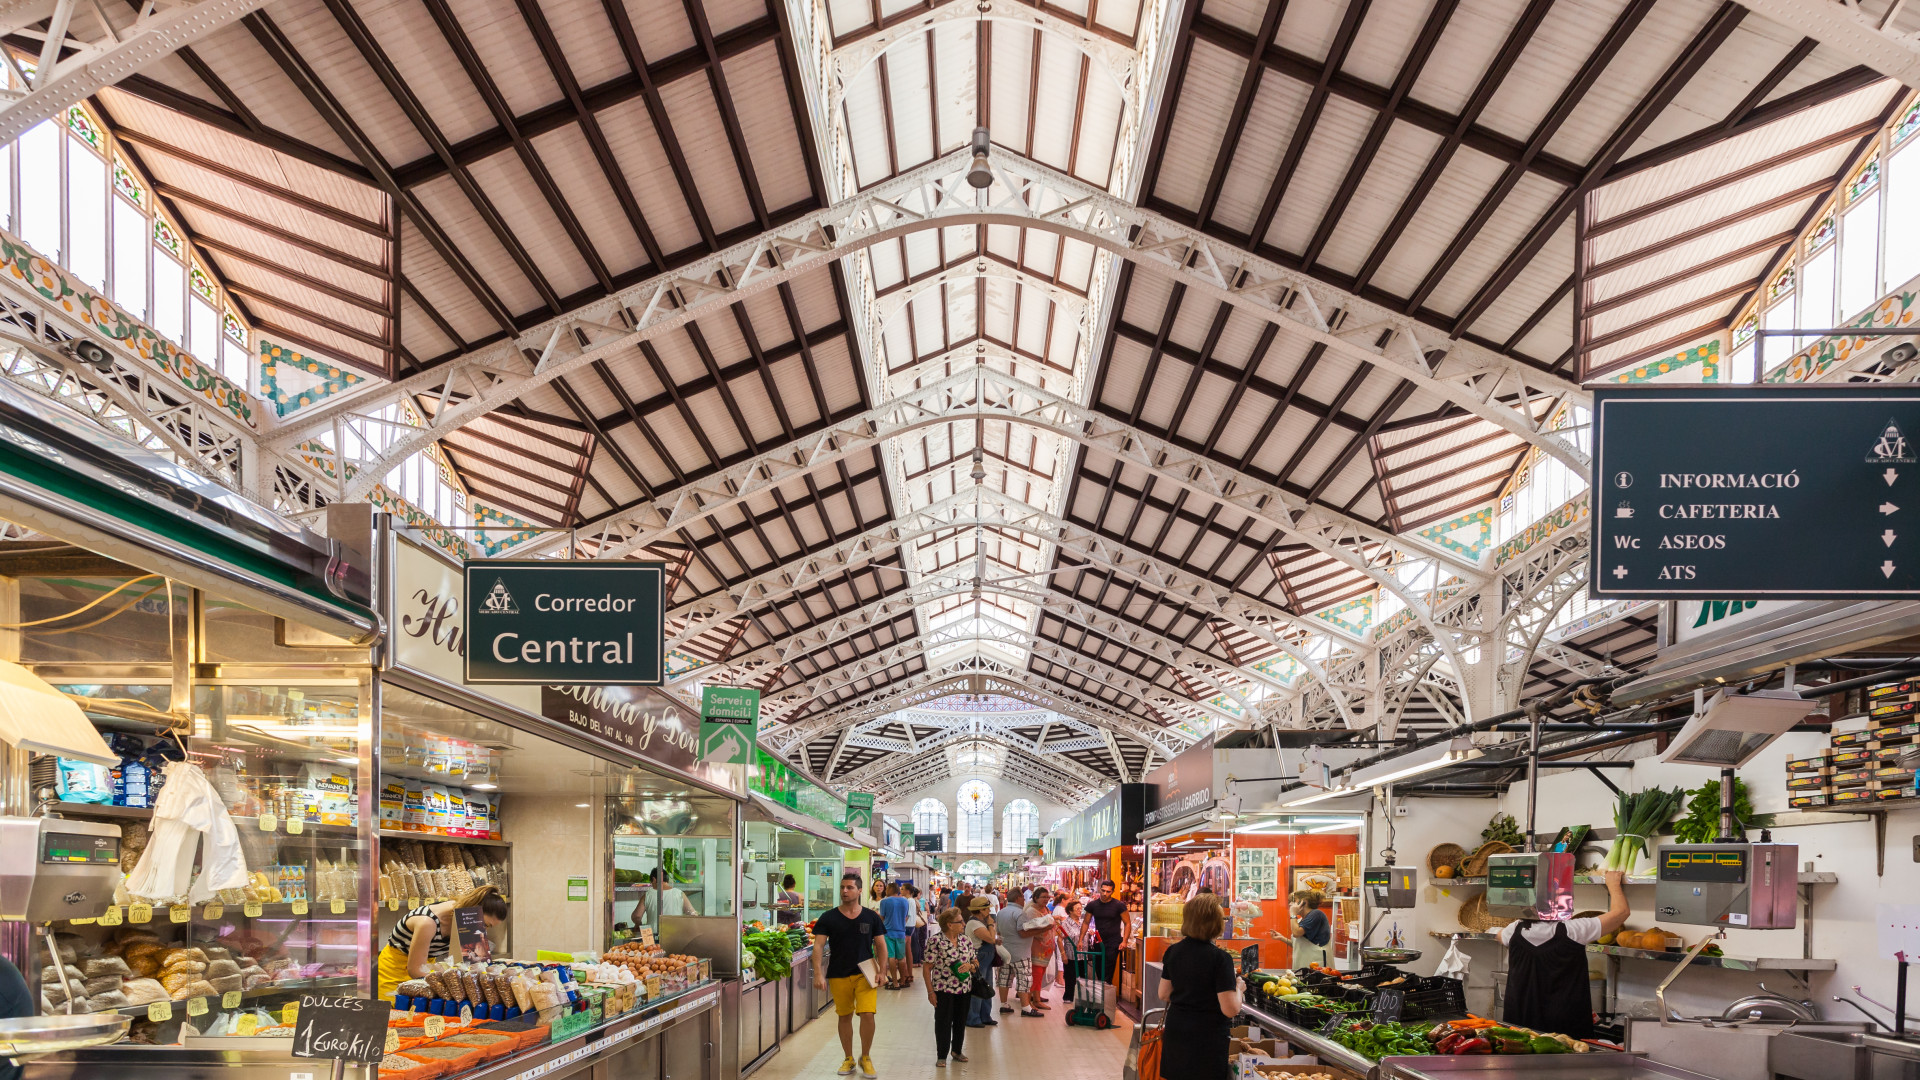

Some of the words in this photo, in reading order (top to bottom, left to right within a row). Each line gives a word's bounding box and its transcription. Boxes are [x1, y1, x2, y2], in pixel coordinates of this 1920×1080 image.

[1659, 469, 1800, 489] INFORMACIÓ
[1659, 504, 1781, 519] CAFETERIA
[1658, 534, 1726, 550] ASEOS
[1657, 565, 1697, 580] ATS
[535, 593, 636, 612] Corredor
[492, 632, 633, 664] Central
[549, 685, 640, 726] aura
[710, 693, 743, 705] Servei
[745, 697, 752, 706] a
[569, 709, 588, 727] BAJO
[589, 718, 602, 734] DEL
[604, 725, 614, 738] 147
[615, 729, 623, 742] AL
[317, 782, 347, 790] ADVANCE
[1659, 906, 1681, 915] DINA
[302, 995, 364, 1011] DULCES
[294, 1019, 315, 1058] 1
